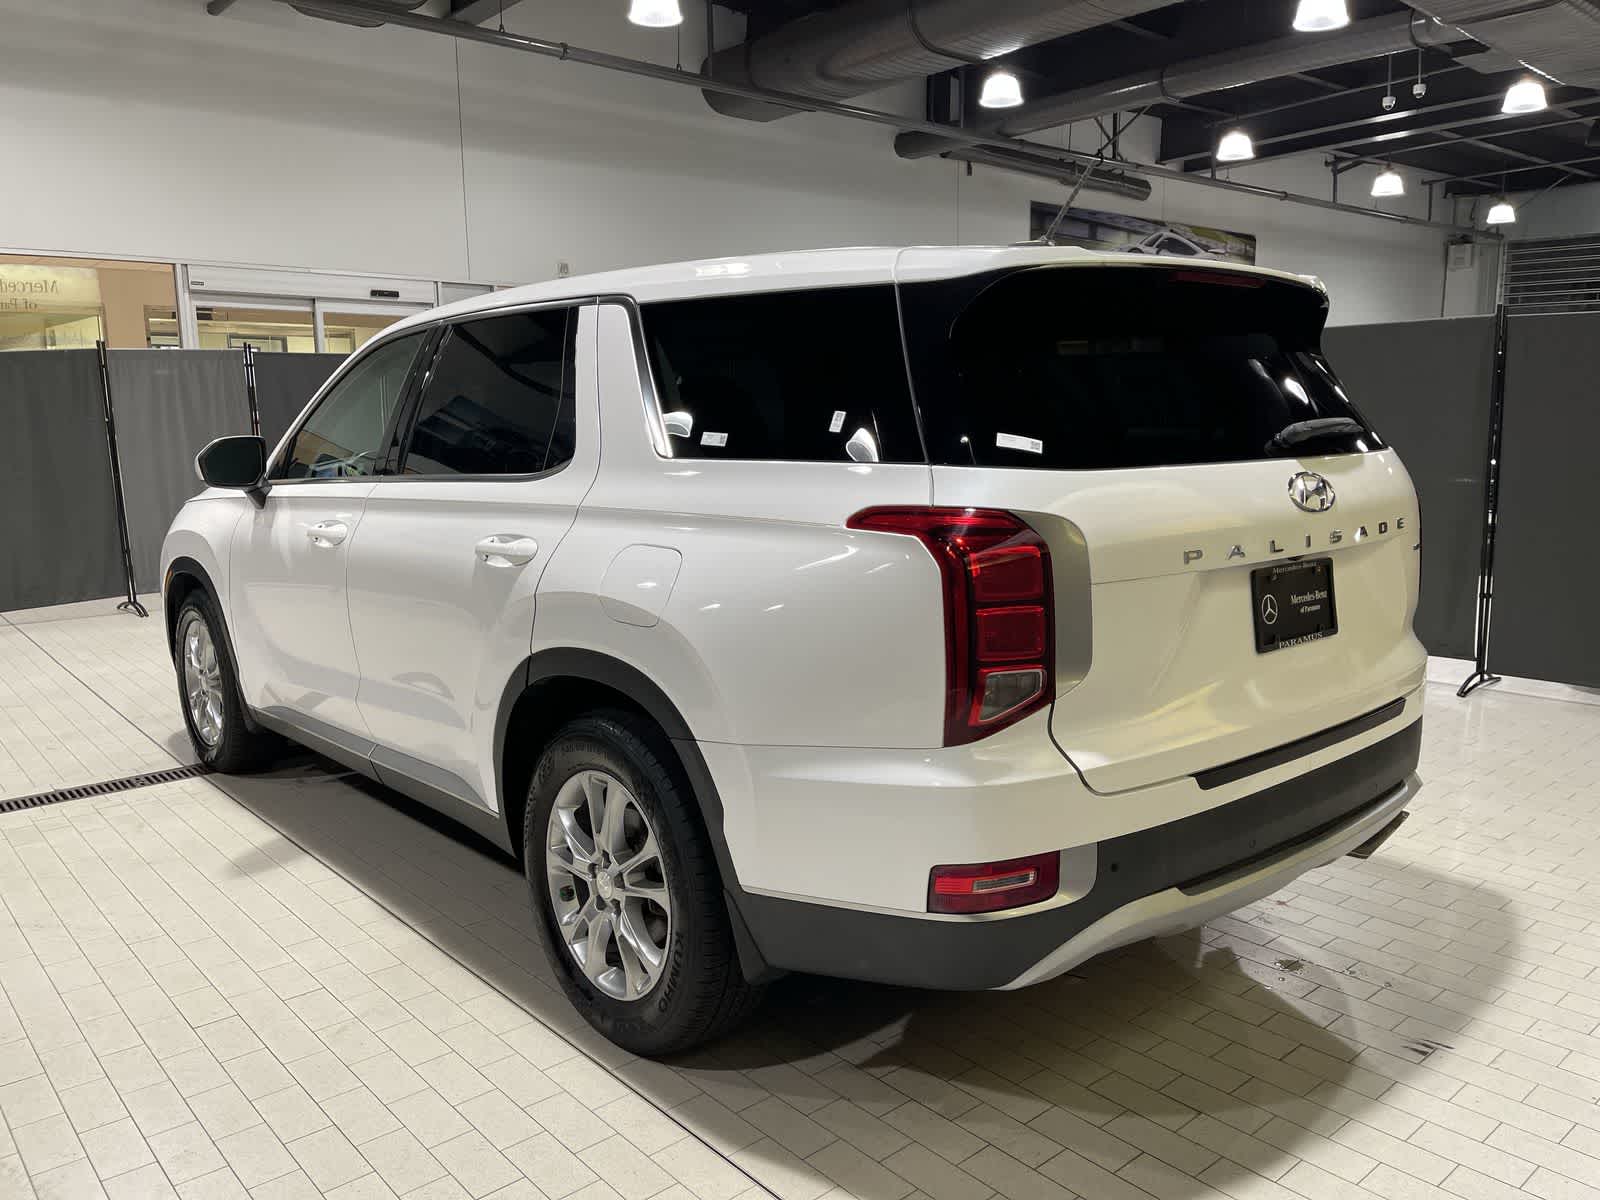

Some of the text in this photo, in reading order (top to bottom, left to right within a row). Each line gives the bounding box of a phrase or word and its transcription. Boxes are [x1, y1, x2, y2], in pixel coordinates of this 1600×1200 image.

[1183, 516, 1406, 565] PALISADE
[1290, 590, 1328, 604] Mercedes-Benz
[1279, 631, 1323, 649] PARAMUS
